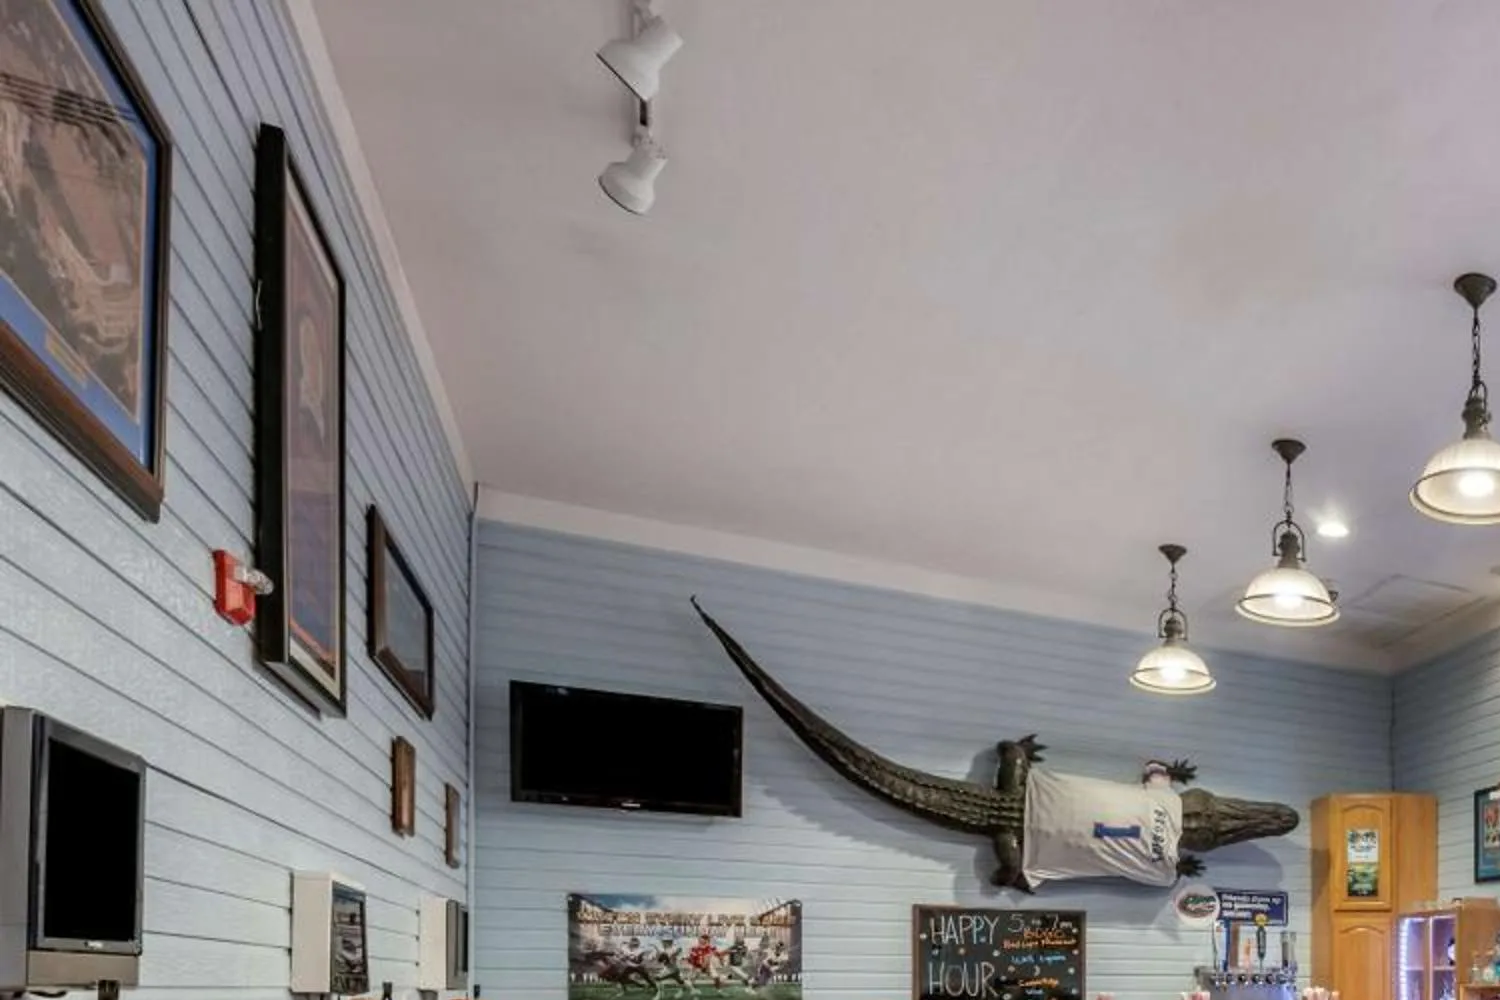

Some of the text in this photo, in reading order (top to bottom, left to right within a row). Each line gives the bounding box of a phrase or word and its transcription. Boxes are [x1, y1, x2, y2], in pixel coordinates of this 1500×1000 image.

[930, 913, 1000, 944] HAPPY
[1007, 913, 1025, 933] 5
[929, 961, 999, 998] HOUR
